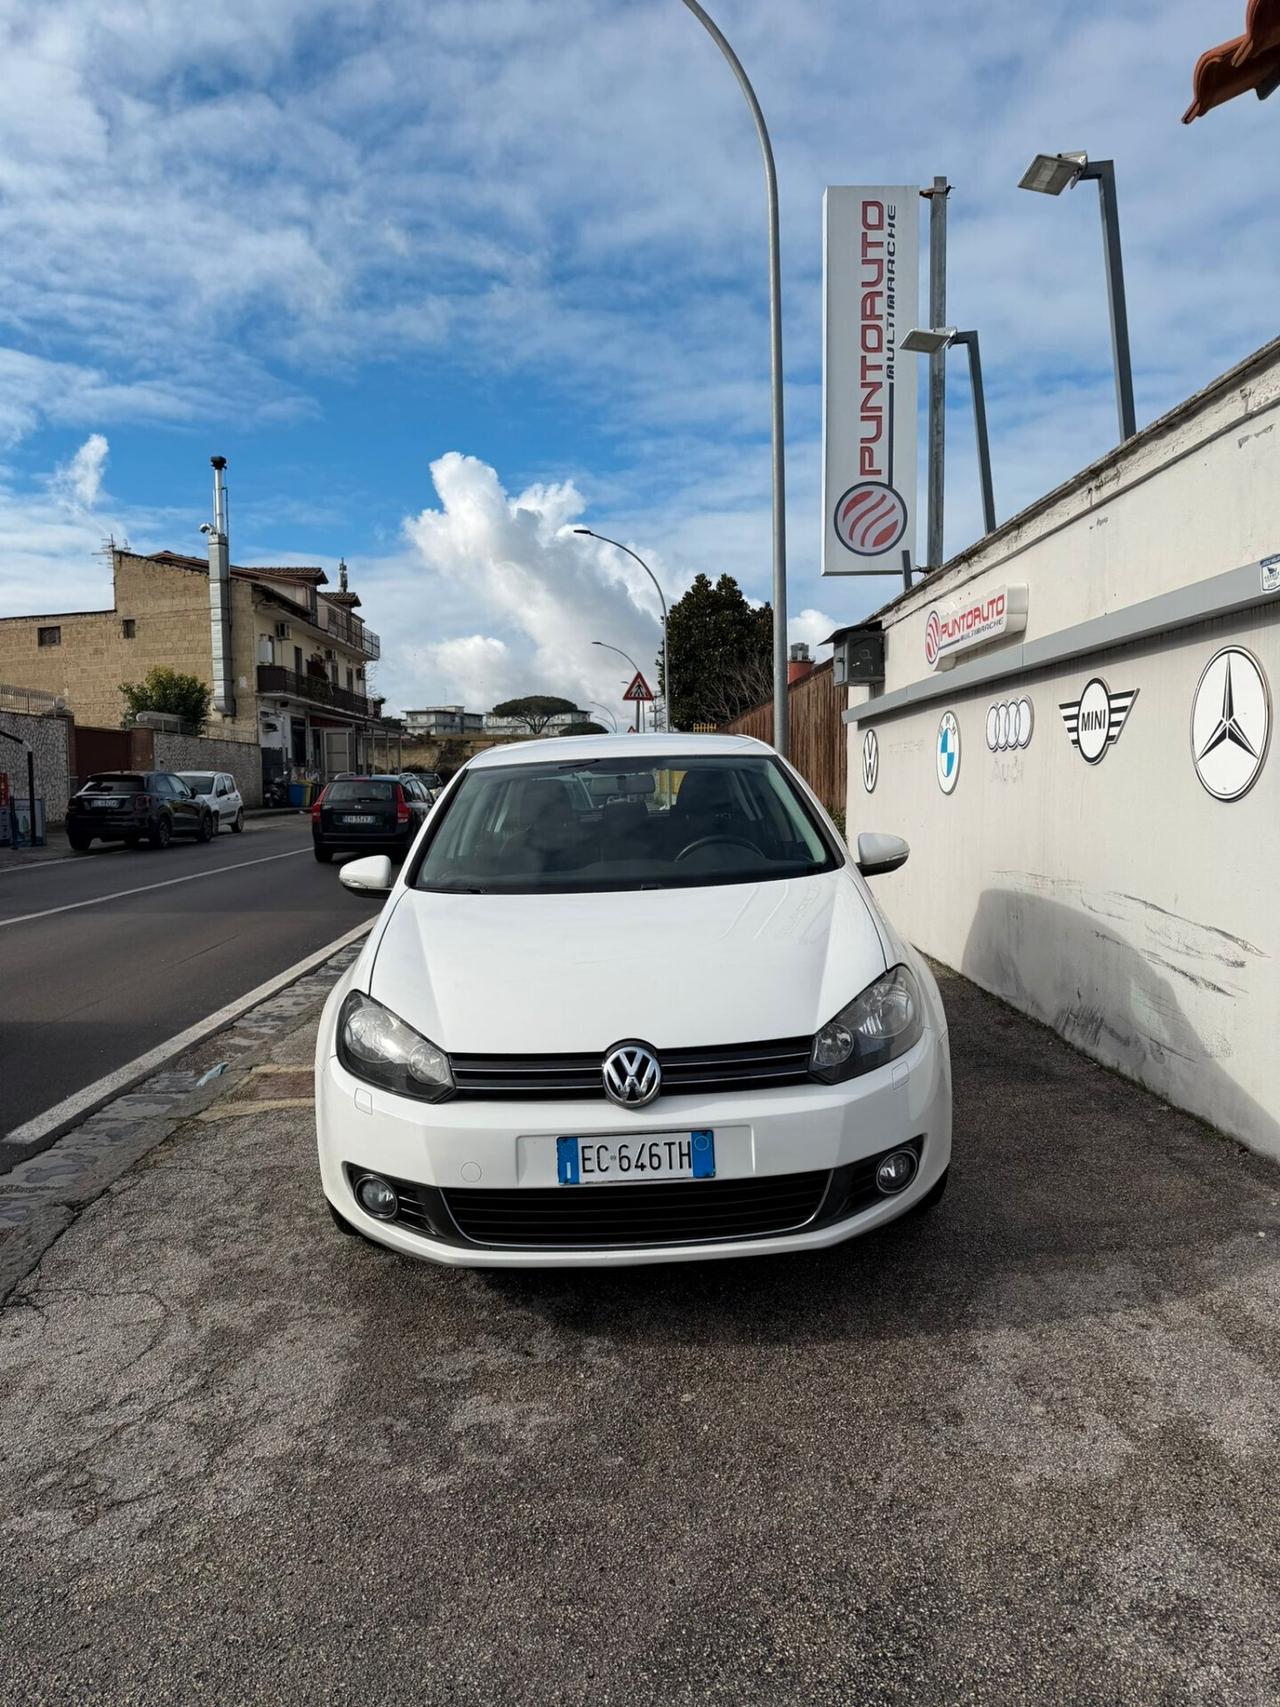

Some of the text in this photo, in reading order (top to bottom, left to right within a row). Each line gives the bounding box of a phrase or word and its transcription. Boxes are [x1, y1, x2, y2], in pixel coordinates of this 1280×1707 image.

[860, 200, 884, 476] PUNTOAUTO
[886, 203, 897, 380] MULTIMARCHE
[940, 594, 1005, 641] PUNTOAUTO
[1081, 708, 1106, 732] MINI
